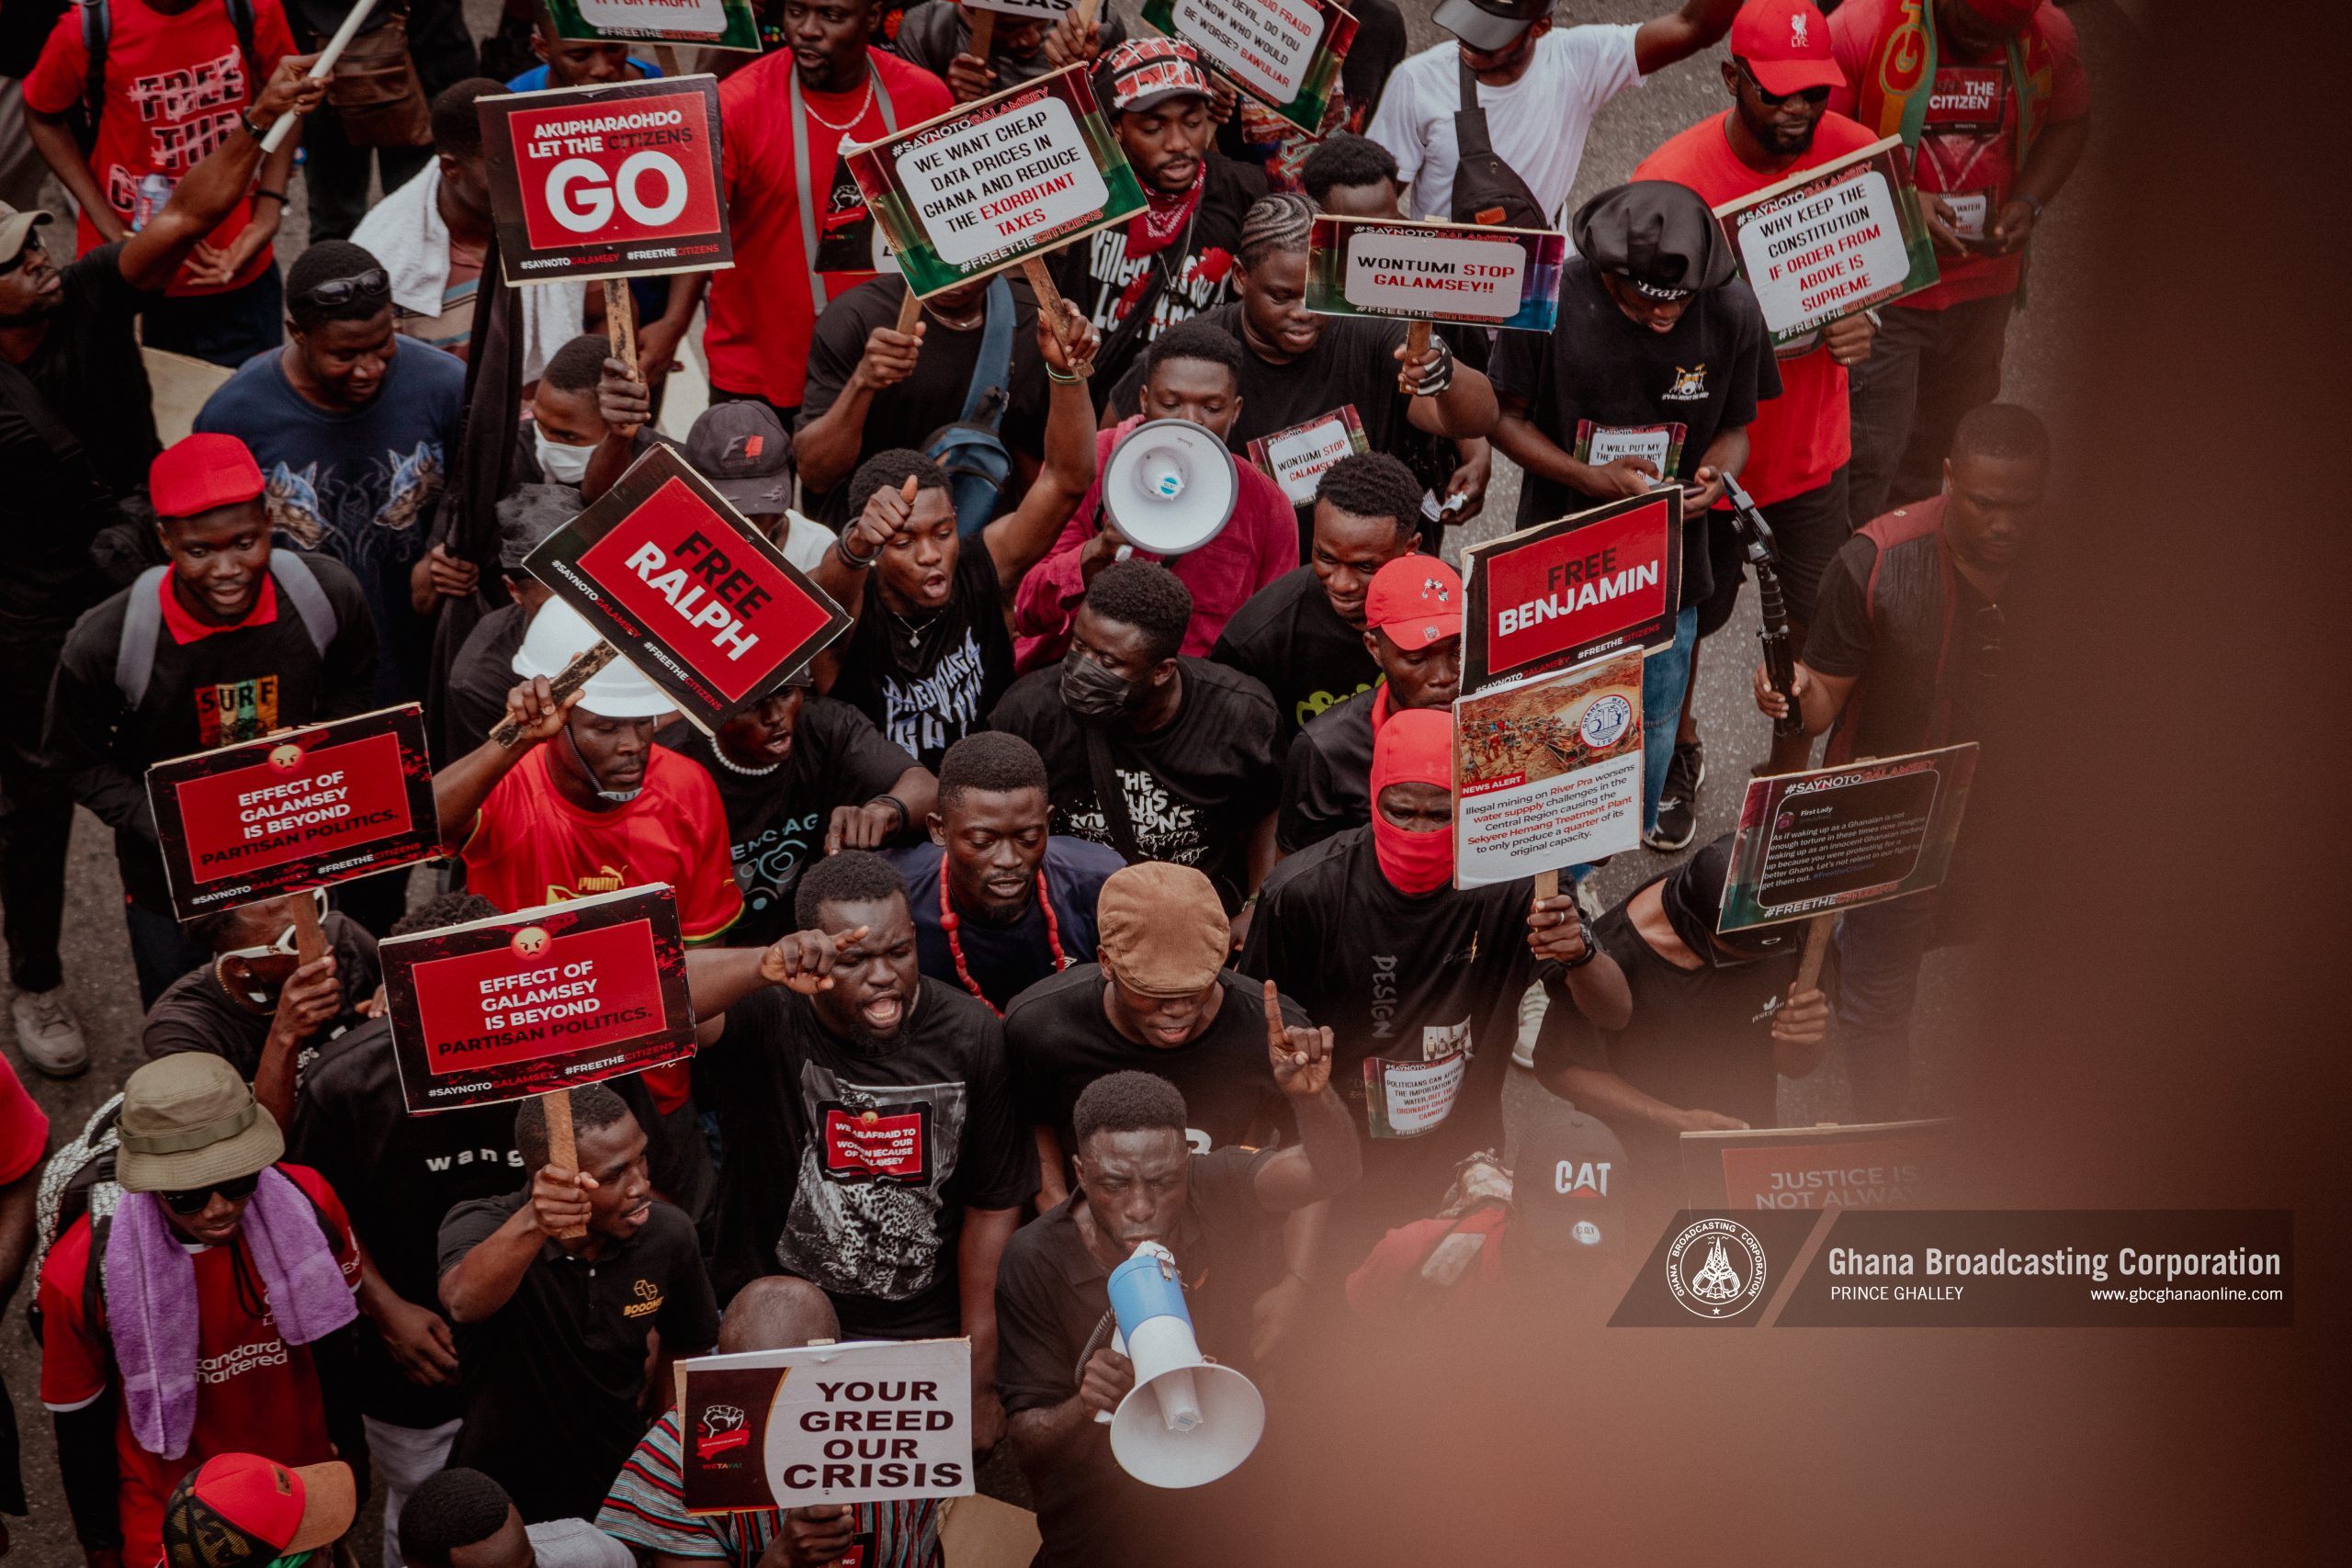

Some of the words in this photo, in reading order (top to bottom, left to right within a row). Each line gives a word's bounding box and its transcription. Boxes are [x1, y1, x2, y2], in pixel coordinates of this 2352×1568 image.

[1264, 20, 1279, 37] DO
[1281, 30, 1301, 51] YOU
[1279, 8, 1312, 37] FRAUD
[1184, 6, 1198, 22] BE
[1199, 17, 1239, 51] WORSE?
[1240, 47, 1291, 88] BAWULIAR
[1230, 17, 1252, 39] WHO
[1254, 35, 1289, 66] WOULD
[1929, 95, 1990, 110] CITIZEN
[1965, 81, 1996, 96] THE
[533, 109, 683, 140] AKUPHARAOHDO
[891, 86, 1049, 158] #SAYNOTOGALAMSEY
[527, 140, 561, 159] LET
[563, 136, 604, 156] THE
[607, 127, 693, 152] CITIZENS
[914, 152, 943, 174] WE
[944, 136, 992, 162] WANT
[995, 111, 1048, 142] CHEAP
[931, 168, 971, 192] DATA
[974, 142, 1032, 174] PRICES
[1035, 134, 1053, 152] IN
[545, 150, 688, 233] GO
[923, 190, 978, 219] GHANA
[982, 173, 1014, 197] AND
[1017, 147, 1081, 182] REDUCE
[1736, 161, 1873, 227] #SAYNOTOGALAMSEY
[945, 211, 979, 232] THE
[979, 172, 1077, 220] EXORBITANT
[1759, 214, 1792, 239] WHY
[1798, 197, 1835, 224] KEEP
[1838, 184, 1868, 201] THE
[995, 208, 1047, 238] TAXES
[1353, 226, 1521, 244] #SAYNOTOGALAMSEY
[1768, 206, 1871, 258] CONSTITUTION
[520, 253, 619, 270] #SAYNOTOGALAMSEY
[627, 243, 720, 261] #FREETHECITIZENS
[959, 209, 1104, 274] #FREETHECITIZENS
[1769, 264, 1781, 282] IF
[1787, 243, 1835, 273] ORDER
[1838, 223, 1882, 252] FROM
[1357, 256, 1456, 275] WONTUMI
[1463, 264, 1516, 278] STOP
[1374, 274, 1495, 294] GALAMSEY!!
[1799, 264, 1847, 292] ABOVE
[1849, 254, 1865, 271] IS
[1801, 273, 1873, 313] SUPREME
[1355, 305, 1505, 324] #FREETHECITIZENS
[1778, 283, 1904, 341] #FREETHECITIZENS
[1278, 449, 1322, 472] WONTUMI
[1323, 439, 1346, 457] STOP
[1607, 445, 1626, 453] WILL
[1629, 444, 1645, 453] PUT
[673, 530, 774, 621] FREE
[1548, 546, 1618, 592] FREE
[624, 540, 761, 661] RALPH
[1498, 559, 1659, 637] BENJAMIN
[551, 559, 642, 638] #SAYNOTOGALAMSEY
[643, 640, 724, 713] #FREETHECITIZENS
[1577, 623, 1661, 660] #FREETHECITIZENS
[200, 681, 274, 714] SURF
[1582, 703, 1601, 729] GHANA
[1611, 696, 1630, 716] WATER
[238, 779, 312, 807] EFFECT
[316, 771, 345, 787] OF
[1462, 783, 1491, 795] NEWS
[1492, 775, 1522, 788] ALERT
[1465, 802, 1496, 816] Illegal
[1497, 793, 1533, 808] mining
[1535, 792, 1548, 801] on
[1550, 783, 1575, 796] River
[1577, 776, 1593, 788] Pra
[1595, 764, 1635, 783] worsens
[1785, 760, 1937, 795] #SAYNOTOGALAMSEY
[240, 787, 348, 823] GALAMSEY
[1474, 812, 1502, 824] water
[1504, 800, 1544, 820] suppply
[1545, 785, 1599, 808] challenges
[1600, 783, 1609, 792] in
[1611, 775, 1628, 788] the
[1485, 818, 1521, 831] Central
[1523, 808, 1558, 824] Region
[1560, 796, 1598, 813] causing
[1600, 790, 1617, 802] the
[1800, 807, 1816, 817] First
[1817, 806, 1833, 815] Lady
[200, 832, 301, 865] PARTISAN
[306, 808, 401, 842] POLITICS.
[243, 824, 264, 840] IS
[266, 804, 351, 834] BEYOND
[1467, 829, 1508, 847] Sekyere
[1510, 820, 1553, 837] Hemang
[1555, 806, 1606, 825] Treatment
[1607, 795, 1633, 810] Plant
[1476, 845, 1487, 853] to
[1488, 838, 1511, 852] only
[1511, 829, 1554, 848] produce
[1563, 817, 1600, 834] quarter
[1600, 812, 1611, 822] of
[1612, 809, 1624, 819] its
[1510, 844, 1547, 858] original
[1549, 831, 1592, 847] capacity.
[1768, 852, 1795, 862] waking
[1800, 836, 1826, 847] torture
[191, 872, 311, 905] #SAYNOTOGALAMSEY
[318, 841, 422, 874] #FREETHECITIZENS
[1763, 869, 1788, 880] better
[1788, 864, 1815, 876] Ghana.
[1816, 861, 1835, 871] Let's
[1777, 856, 1810, 868] because
[1810, 854, 1826, 863] you
[1775, 877, 1795, 888] them
[1764, 883, 1898, 919] #FREETHECITIZENS
[479, 967, 559, 995] EFFECT
[563, 960, 594, 978] OF
[481, 978, 598, 1013] GALAMSEY
[1372, 954, 1399, 1039] DESIGN
[437, 1026, 546, 1055] PARTISAN
[551, 1006, 654, 1038] POLITICS.
[484, 1016, 505, 1031] IS
[510, 998, 601, 1026] BEYOND
[428, 1070, 556, 1098] #SAYNOTOGALAMSEY
[564, 1041, 676, 1076] #FREETHECITIZENS
[1386, 1079, 1427, 1089] POLITICIANS
[1429, 1076, 1442, 1085] CAN
[1409, 1080, 1452, 1097] IMPORTATION
[1419, 1108, 1443, 1121] CANNOT
[902, 1128, 917, 1137] TO
[426, 1148, 526, 1172] wang
[1555, 1160, 1611, 1197] CAT
[1770, 1167, 1883, 1191] JUSTICE
[1893, 1165, 1918, 1183] IS
[1756, 1190, 1815, 1210] NOT
[195, 1349, 288, 1384] hartered
[196, 1338, 281, 1371] tandard
[816, 1381, 938, 1403] YOUR
[799, 1410, 955, 1432] GREED
[823, 1438, 920, 1460] OUR
[783, 1462, 963, 1490] CRISIS
